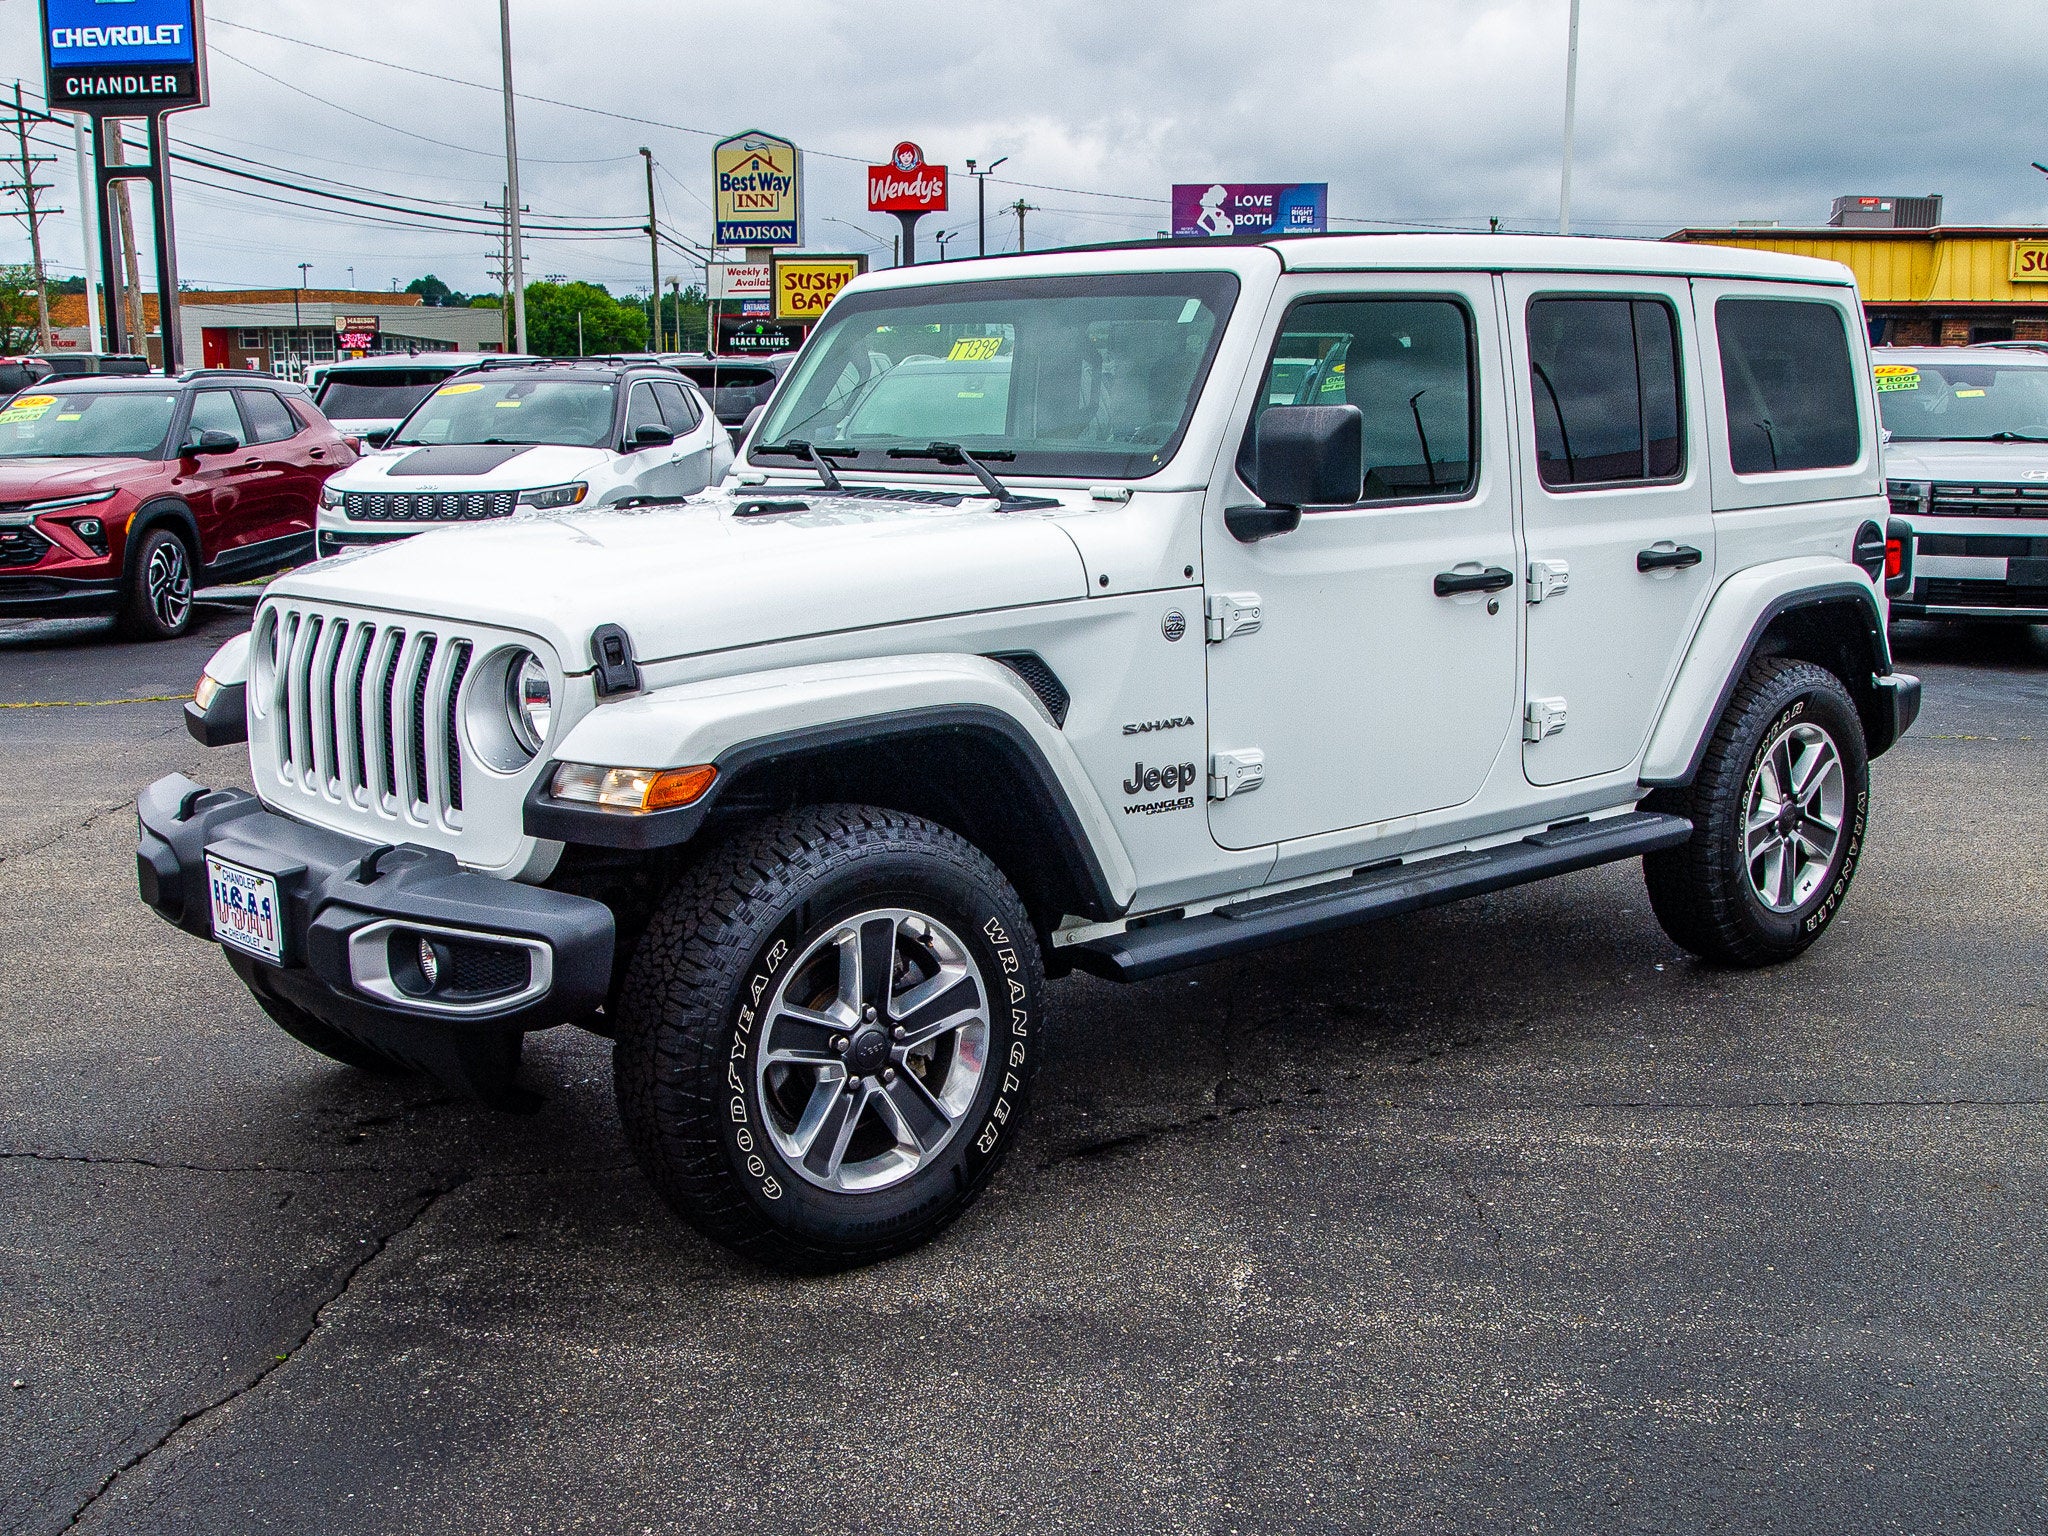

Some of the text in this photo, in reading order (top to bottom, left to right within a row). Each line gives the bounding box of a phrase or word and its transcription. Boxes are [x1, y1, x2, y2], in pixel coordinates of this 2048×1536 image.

[52, 24, 184, 48] CHEVROLET
[66, 75, 178, 96] CHANDLER
[720, 172, 792, 197] Best Way
[870, 171, 943, 205] Wendy's
[737, 193, 775, 208] INN
[1235, 195, 1273, 207] LOVE
[1235, 214, 1273, 226] BOTH
[1291, 215, 1314, 224] LIFE
[721, 225, 793, 240] MADISON
[727, 267, 761, 278] Weekly
[784, 272, 849, 291] SUSHI
[730, 337, 790, 346] BLACK OLIVES
[1886, 383, 1916, 391] CLEAN
[1122, 716, 1195, 736] SAHARA
[1123, 762, 1196, 795] Jeep
[1123, 796, 1195, 815] WRANGLER
[1807, 791, 1866, 932] WRANGLER
[222, 869, 256, 891] CHANDLER
[228, 928, 260, 947] CHEVROLET
[977, 917, 1028, 1154] WRANGLER
[728, 938, 789, 1200] GOODYEAR
